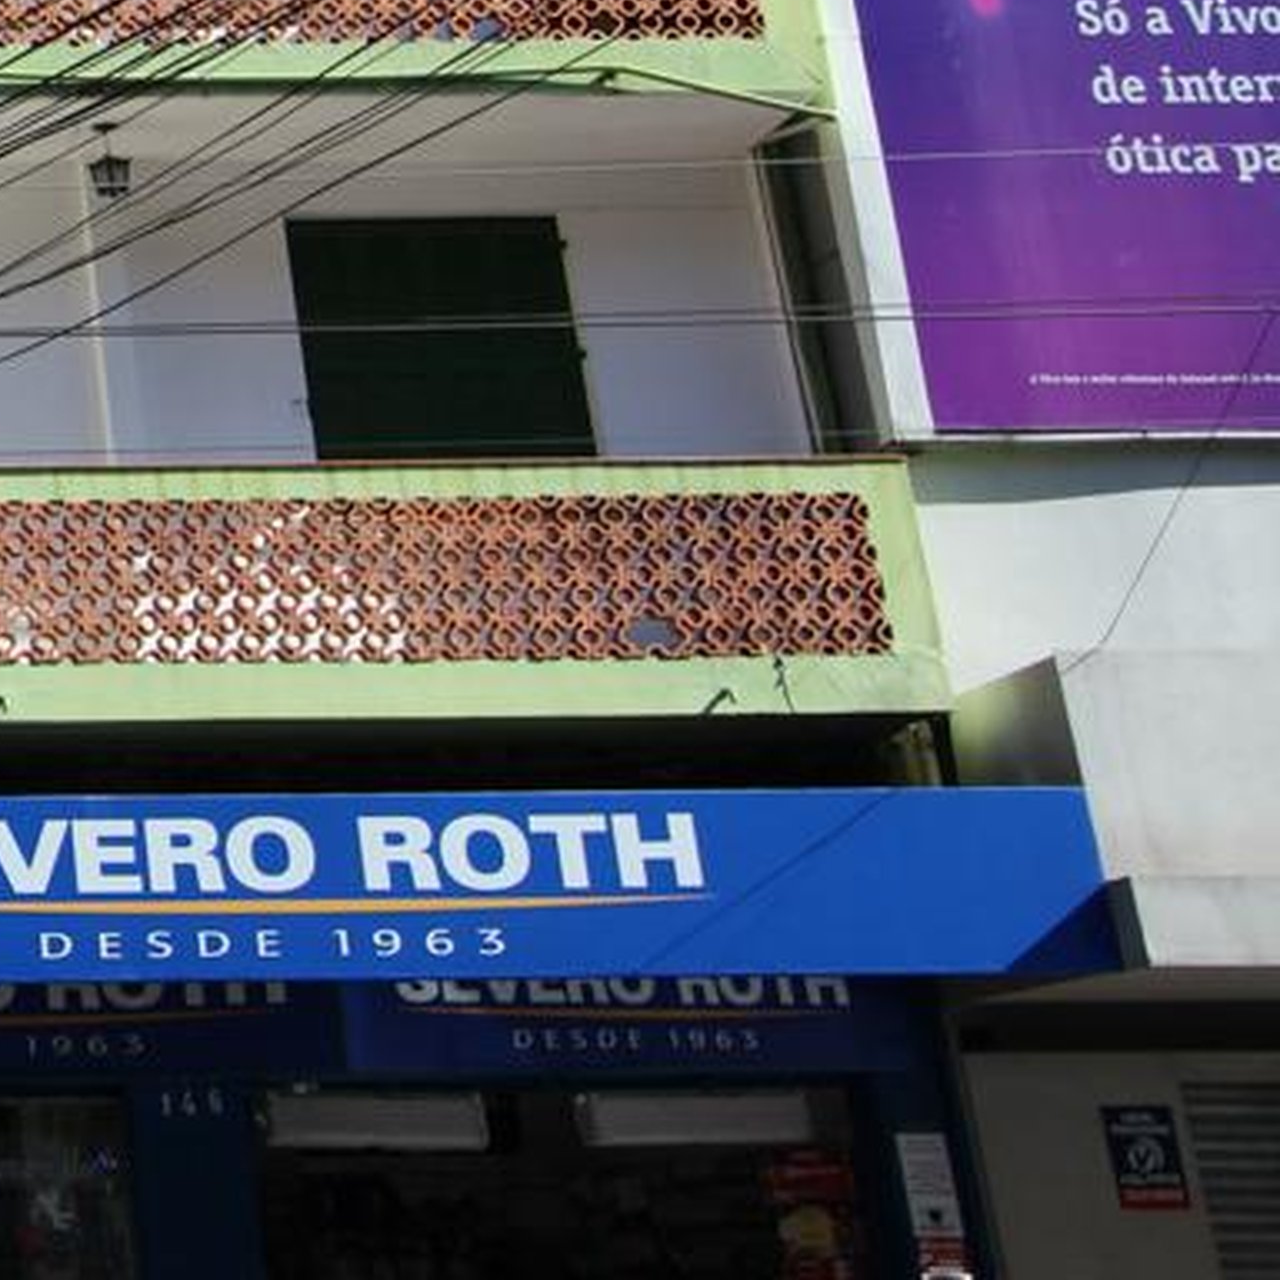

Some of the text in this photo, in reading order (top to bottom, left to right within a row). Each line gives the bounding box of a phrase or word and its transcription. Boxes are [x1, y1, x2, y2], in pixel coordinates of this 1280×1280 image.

[1145, 6, 1175, 36] a
[1092, 65, 1147, 104] de
[1105, 133, 1222, 174] ótica
[357, 812, 706, 893] ROTH
[37, 927, 507, 960] DESDE 1963
[25, 1033, 150, 1057] 1963
[511, 1028, 762, 1052] DESDE 1963
